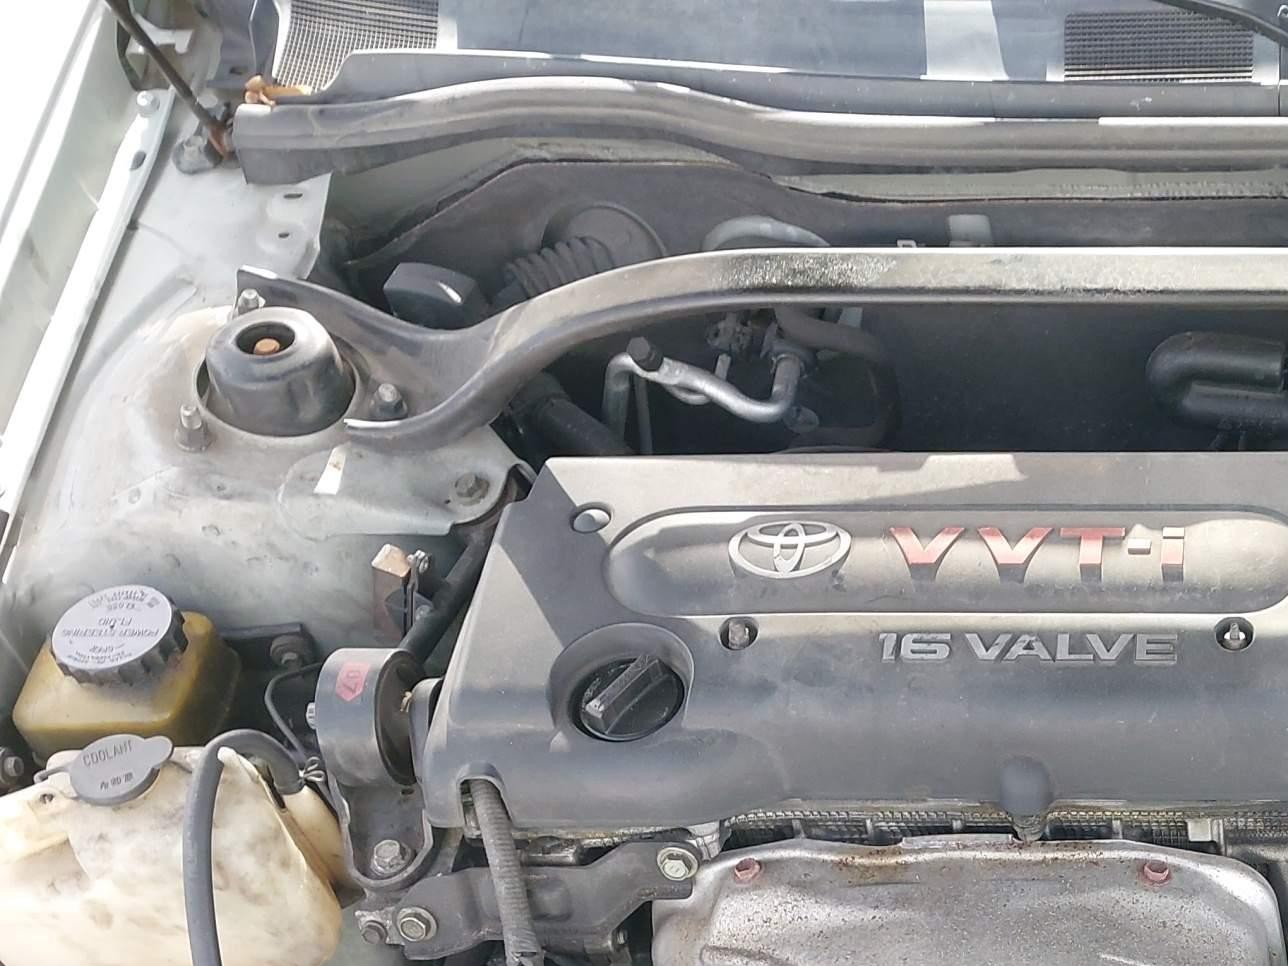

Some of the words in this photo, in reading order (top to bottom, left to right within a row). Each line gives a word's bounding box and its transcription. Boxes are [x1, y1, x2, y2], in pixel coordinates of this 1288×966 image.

[890, 527, 1185, 583] VVT-i
[880, 632, 952, 662] 16
[964, 632, 1178, 663] VALVE
[82, 739, 132, 767] COOLANT
